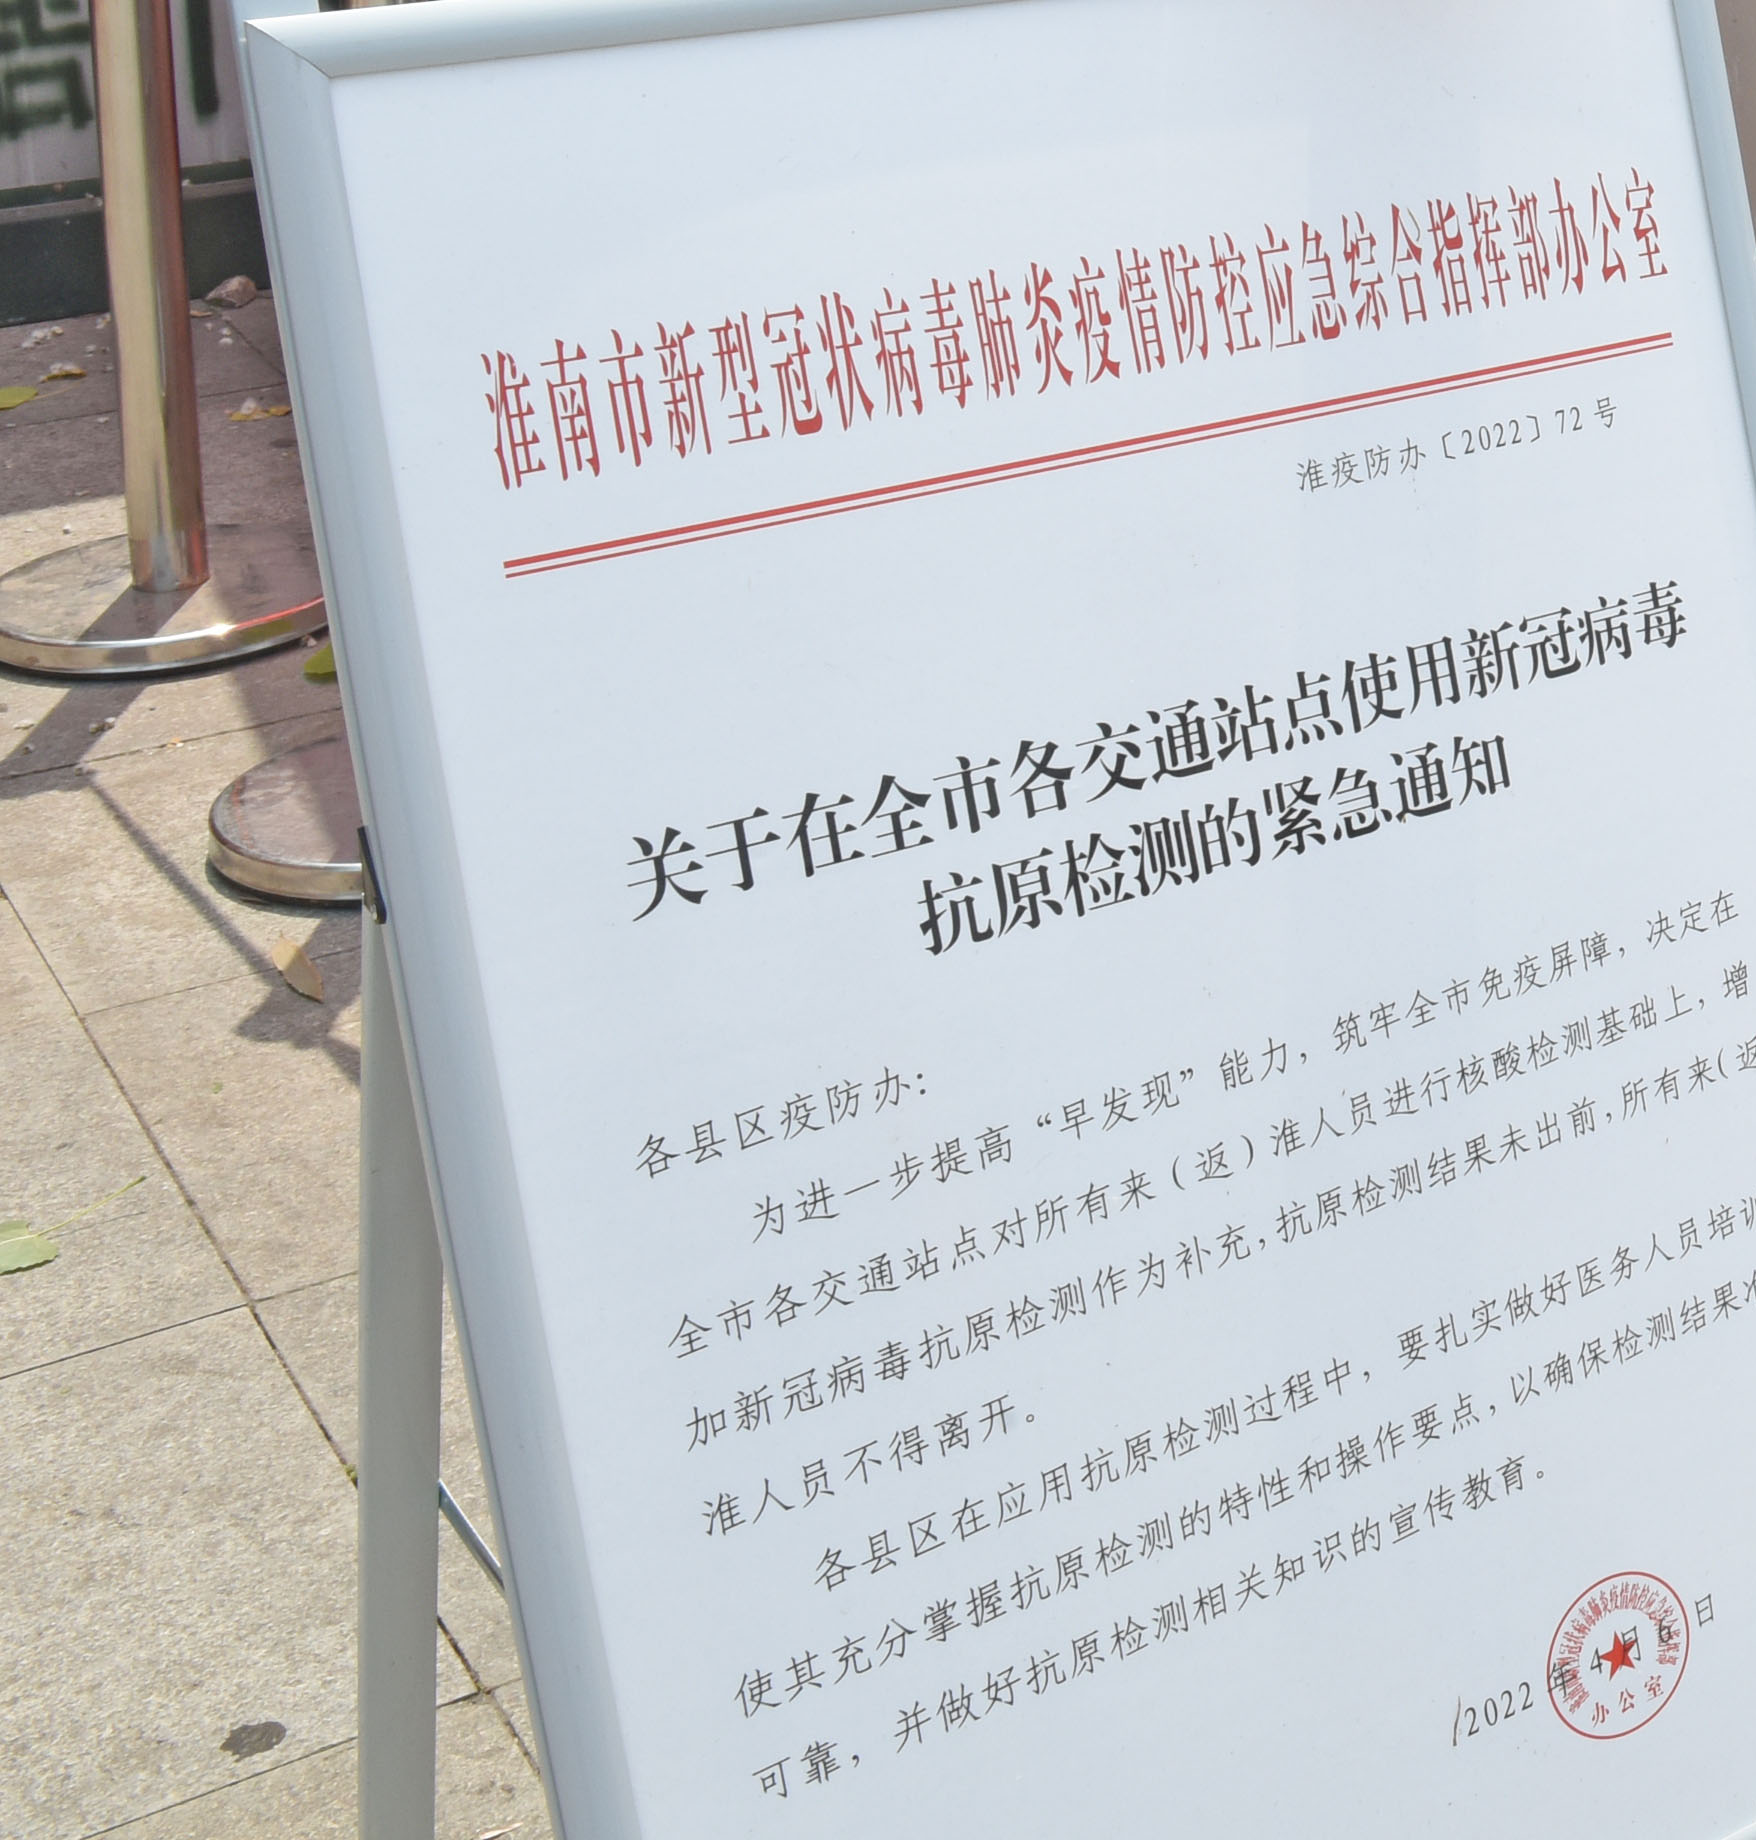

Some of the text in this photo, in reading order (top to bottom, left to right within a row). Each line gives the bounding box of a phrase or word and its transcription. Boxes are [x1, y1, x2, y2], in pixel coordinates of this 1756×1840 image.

[481, 166, 1670, 489] 淮南市新型冠状病毒肺炎疫情防控应急综合指挥部办公室
[624, 579, 1688, 923] 关于在全市各交通站点使用新冠病毒
[917, 734, 1512, 956] 抗原检测的紧急通知
[635, 1066, 927, 1179] 各县区疫防办：
[668, 961, 1751, 1360] 全市各交通站点对所有来（返）淮人员进行核酸检测基础上，增
[702, 1394, 1036, 1538] 淮人员不得离开。
[752, 1455, 1546, 1800] 可靠，并做好抗原检测相关知识的宣传教育。
[1592, 1675, 1665, 1728] 办公室
